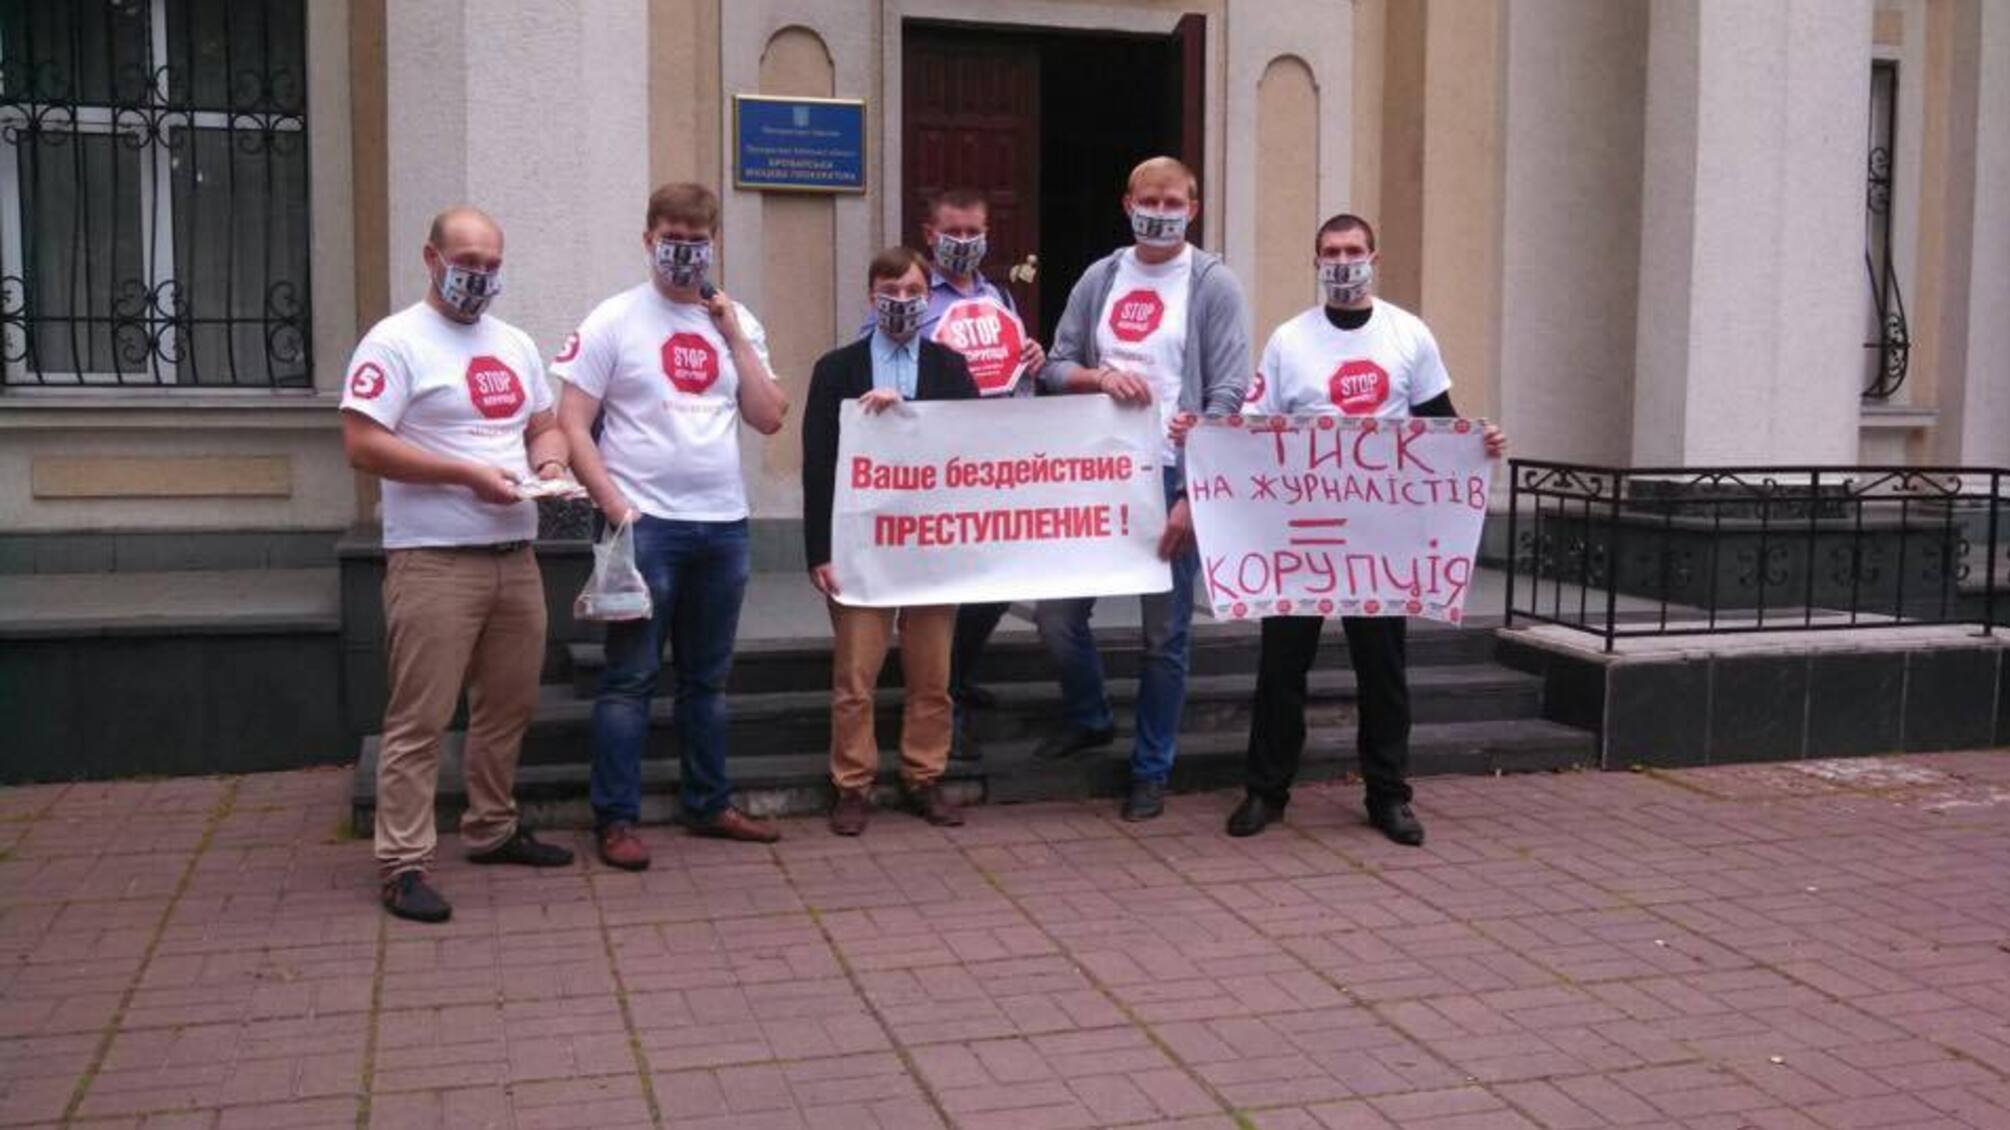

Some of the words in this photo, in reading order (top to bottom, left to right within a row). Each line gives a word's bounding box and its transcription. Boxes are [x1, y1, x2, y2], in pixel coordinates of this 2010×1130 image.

[1121, 302, 1156, 321] STOP
[950, 315, 1001, 349] STOP
[673, 346, 708, 369] STOP
[475, 370, 511, 393] STOP
[1340, 373, 1378, 396] STOP
[1250, 426, 1435, 474] ТИСК
[851, 456, 937, 490] Ваше
[945, 452, 1132, 490] бездействие
[1193, 475, 1233, 501] НА
[874, 505, 1111, 547] ПРЕСТУПЛЕНИЕ
